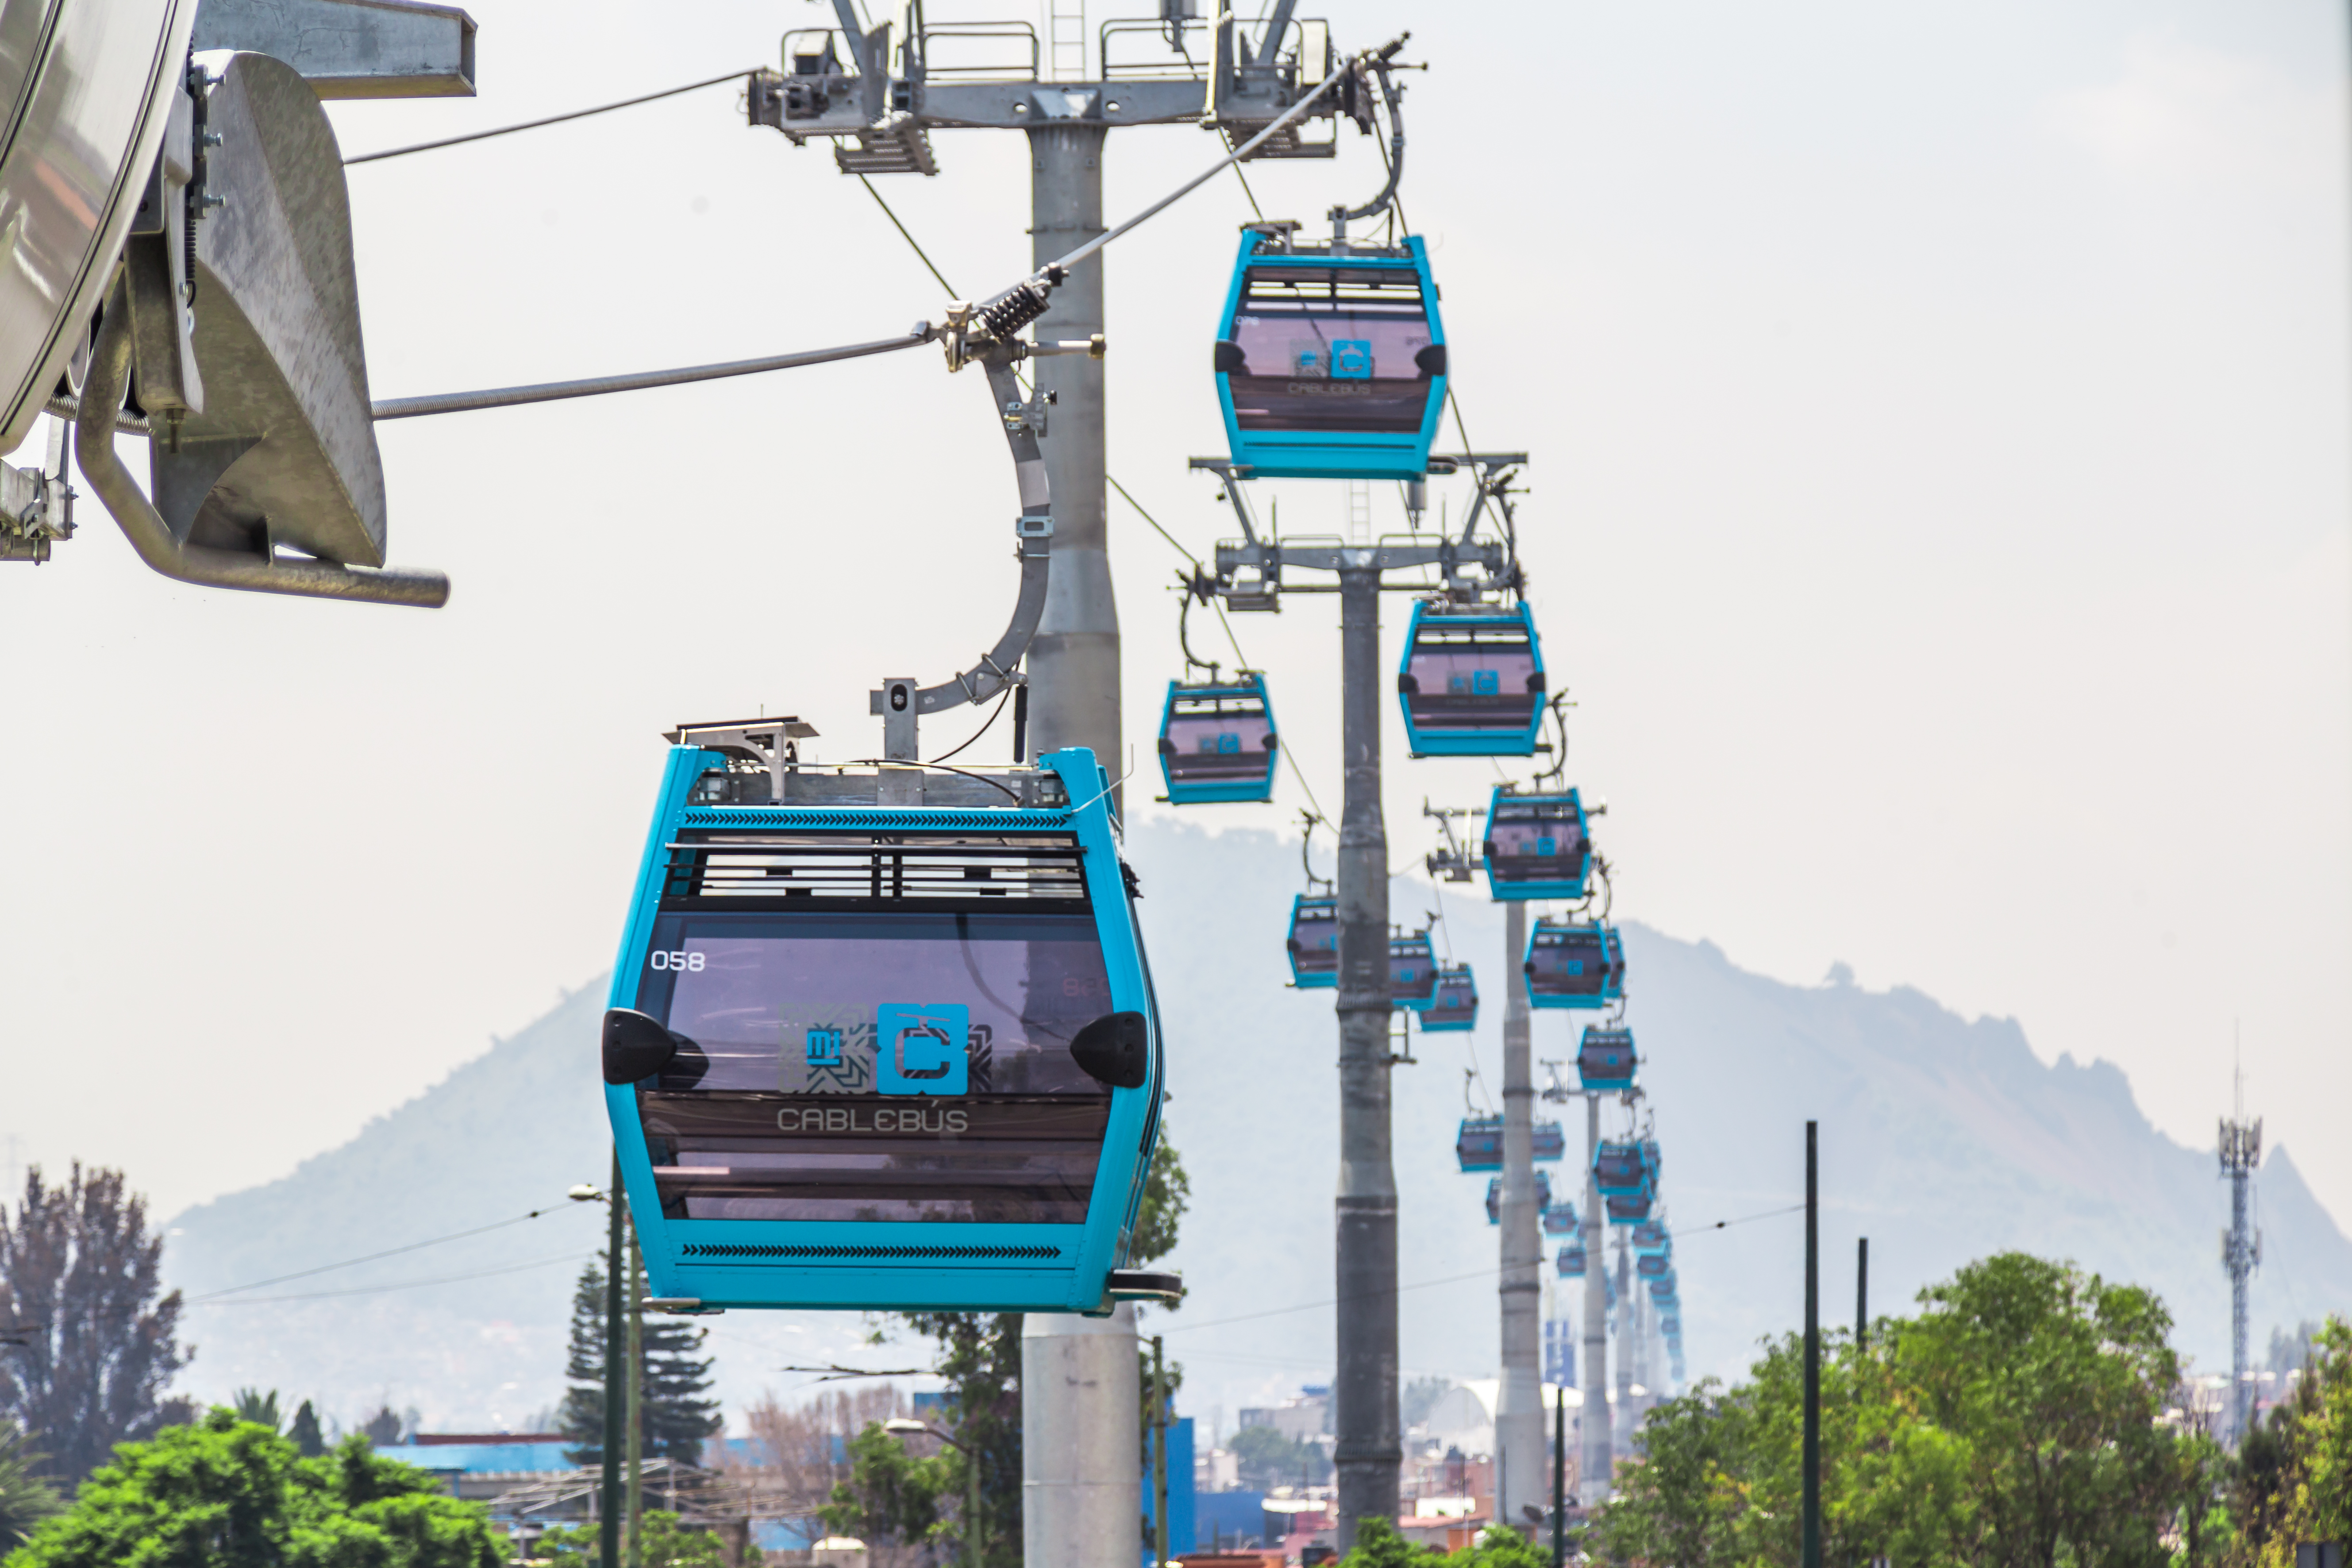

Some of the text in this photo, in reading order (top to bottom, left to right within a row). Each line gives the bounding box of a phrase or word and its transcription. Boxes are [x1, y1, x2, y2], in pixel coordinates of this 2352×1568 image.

[1339, 348, 1364, 372] C
[651, 950, 705, 972] 058
[777, 1099, 969, 1132] CABLEBÚS
